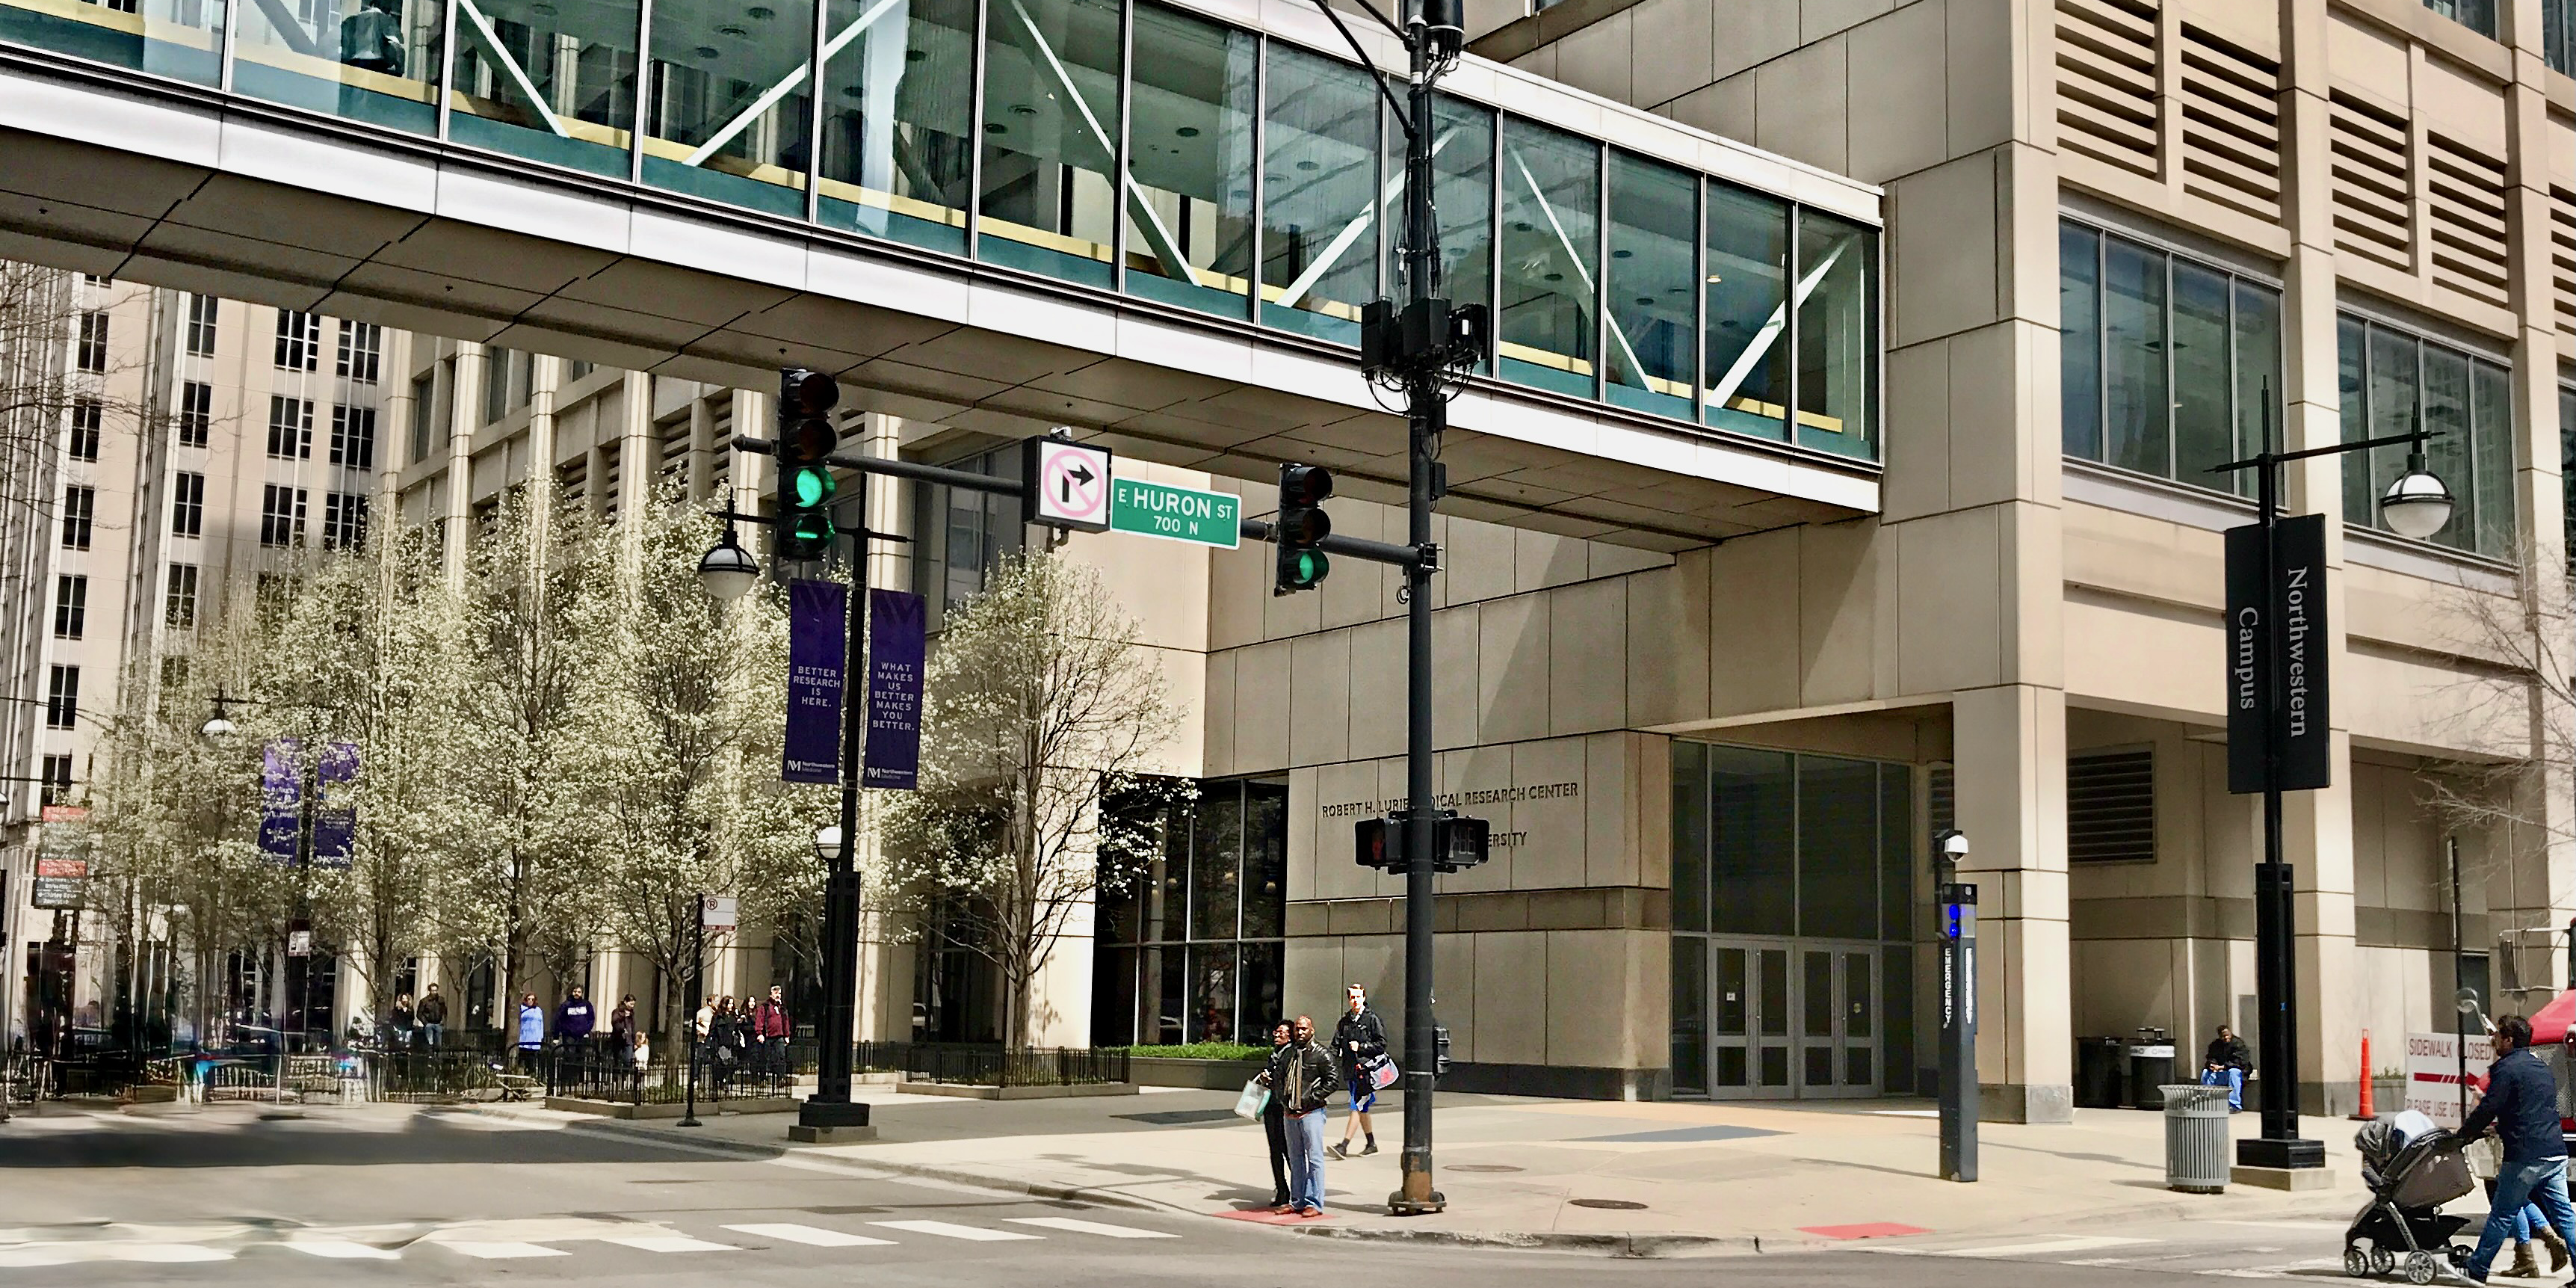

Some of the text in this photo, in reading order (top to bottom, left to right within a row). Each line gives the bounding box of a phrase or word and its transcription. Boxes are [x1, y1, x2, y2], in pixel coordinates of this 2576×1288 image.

[1119, 487, 1233, 520] E HURON ST
[1153, 516, 1199, 536] 700 N
[2288, 566, 2309, 738] Northwestern
[2234, 607, 2258, 709] Campus
[797, 666, 837, 678] BETTER
[881, 662, 912, 672] WHAT
[793, 676, 841, 688] RESEARCH
[877, 671, 913, 682] MAKES
[812, 688, 821, 696] IS
[888, 682, 901, 691] US
[801, 696, 832, 707] HERE.
[874, 691, 915, 702] BETTER
[876, 700, 912, 711] MAKES
[882, 711, 903, 720] YOU
[872, 720, 915, 731] BETTER.
[1322, 782, 1578, 818] ROBERT H. LURIE ICAL RESEARCH CENTER
[2408, 1038, 2491, 1060] SIDEWALK OSED
[2434, 1101, 2447, 1117] USE
